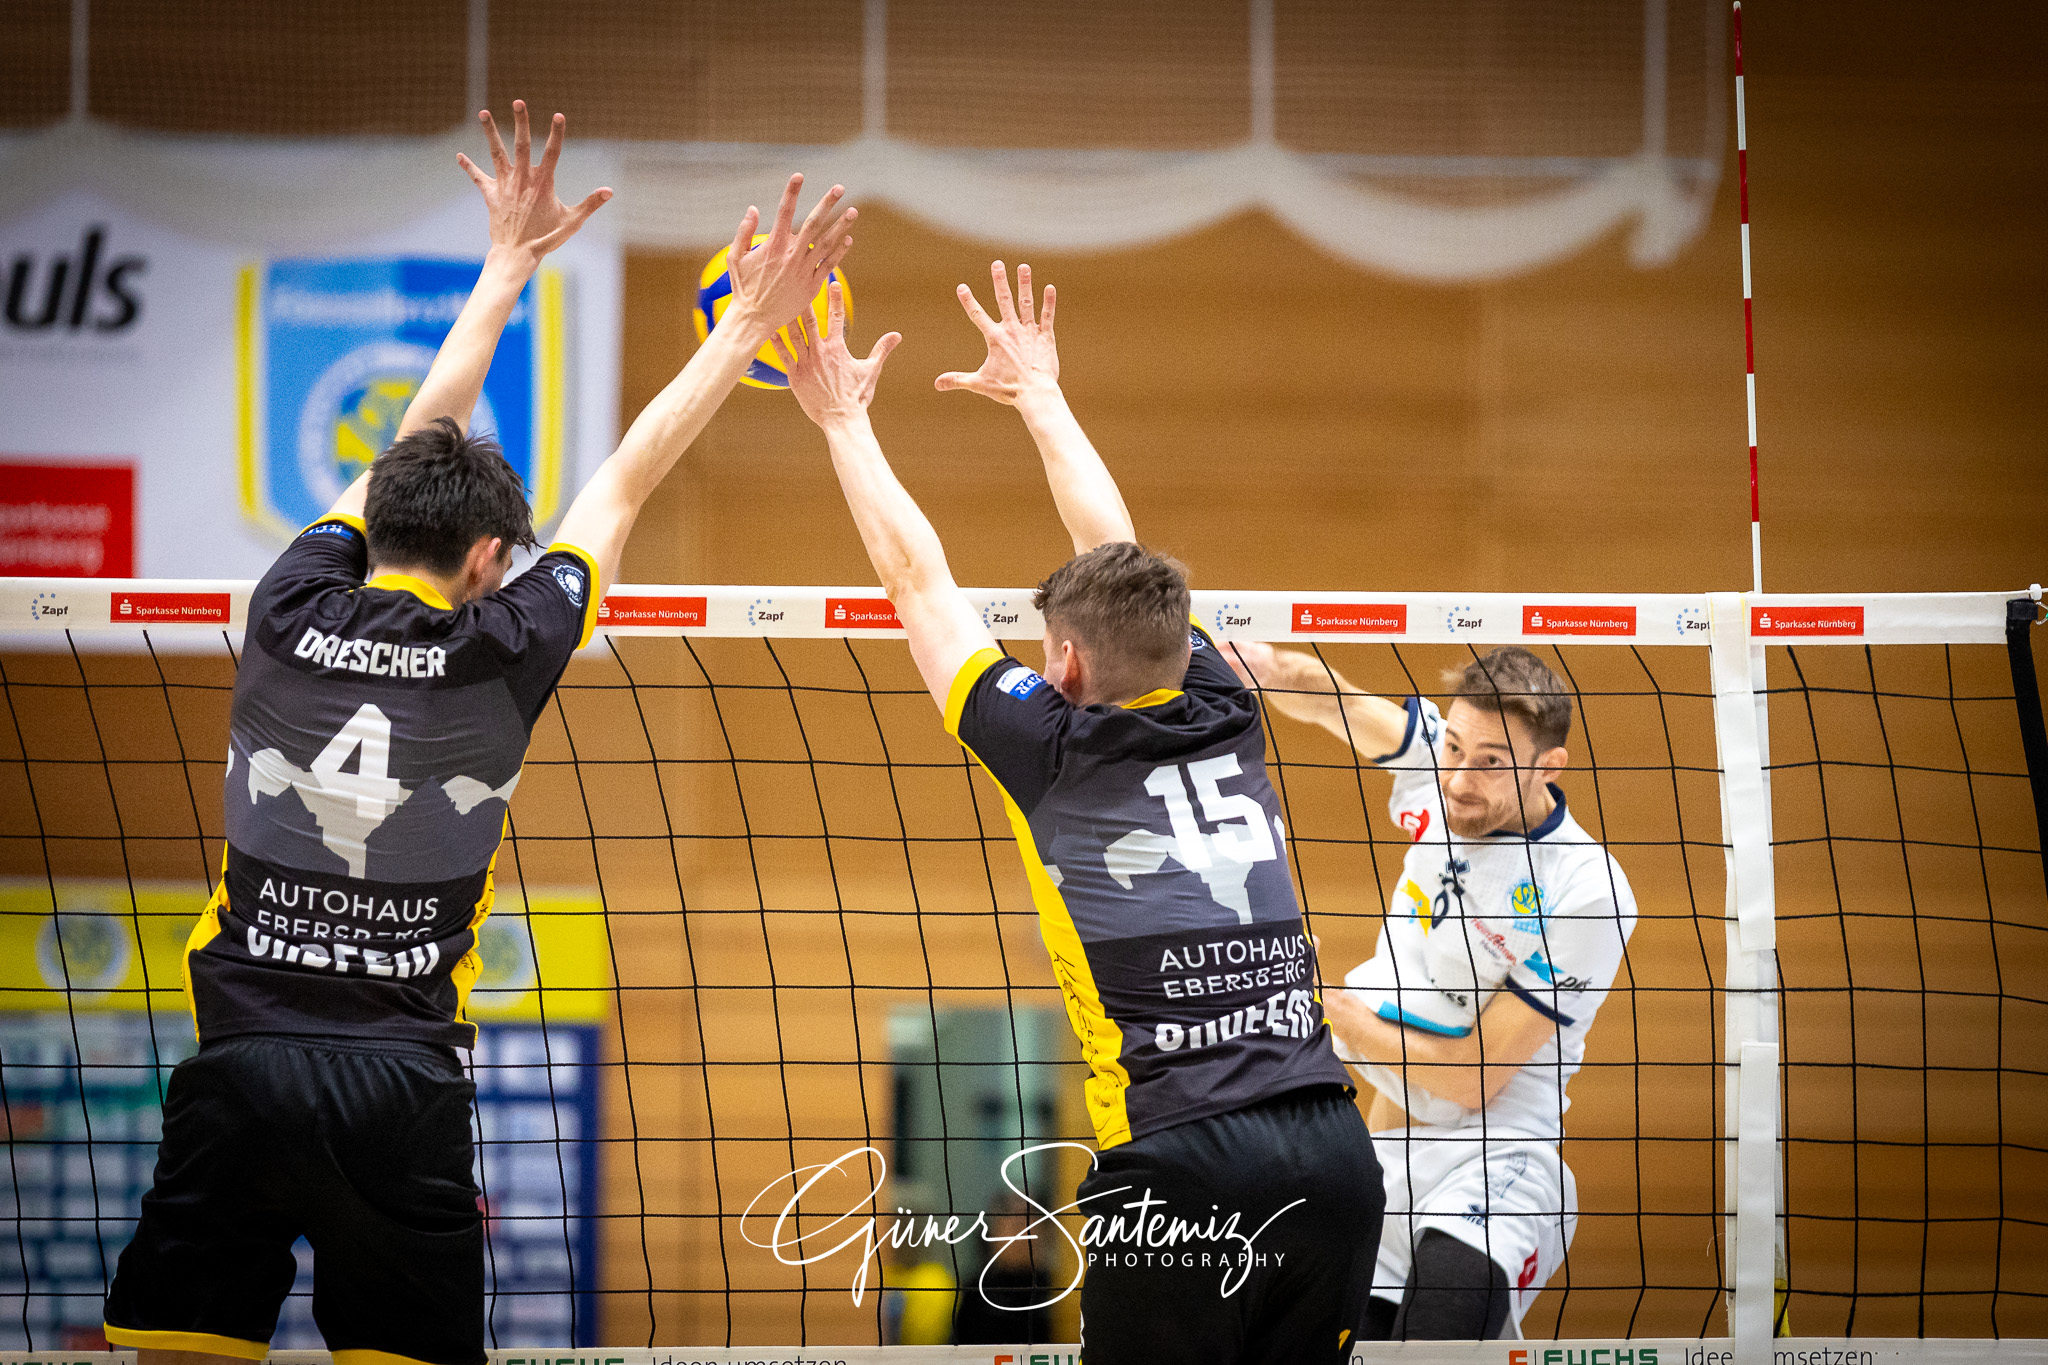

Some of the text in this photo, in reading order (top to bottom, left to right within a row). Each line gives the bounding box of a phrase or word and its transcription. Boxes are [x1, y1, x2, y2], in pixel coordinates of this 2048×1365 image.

[41, 605, 69, 616] Zapf
[135, 605, 222, 617] Sparkasse Nürnberg
[613, 609, 699, 620] Sparkasse Nürnberg
[758, 611, 785, 622] Zapf
[850, 611, 893, 621] Sparkasse
[993, 613, 1019, 624] Zapf
[1226, 616, 1252, 626] Zapf
[1316, 616, 1399, 627] Sparkasse Nürnberg
[1457, 618, 1483, 629] Zapf
[1546, 618, 1629, 630] Sparkasse Nürnberg
[1774, 618, 1857, 630] Sparkasse Nürnberg
[294, 627, 447, 678] DRESCHER
[309, 703, 400, 820] 4
[1143, 752, 1277, 872] 15
[259, 878, 439, 923] AUTOHAUS
[1160, 934, 1306, 972] AUTOHAUS
[1163, 958, 1306, 999] EBERSBERG
[1543, 1348, 1658, 1365] FUCHS
[1773, 1347, 1873, 1365] msetzen
